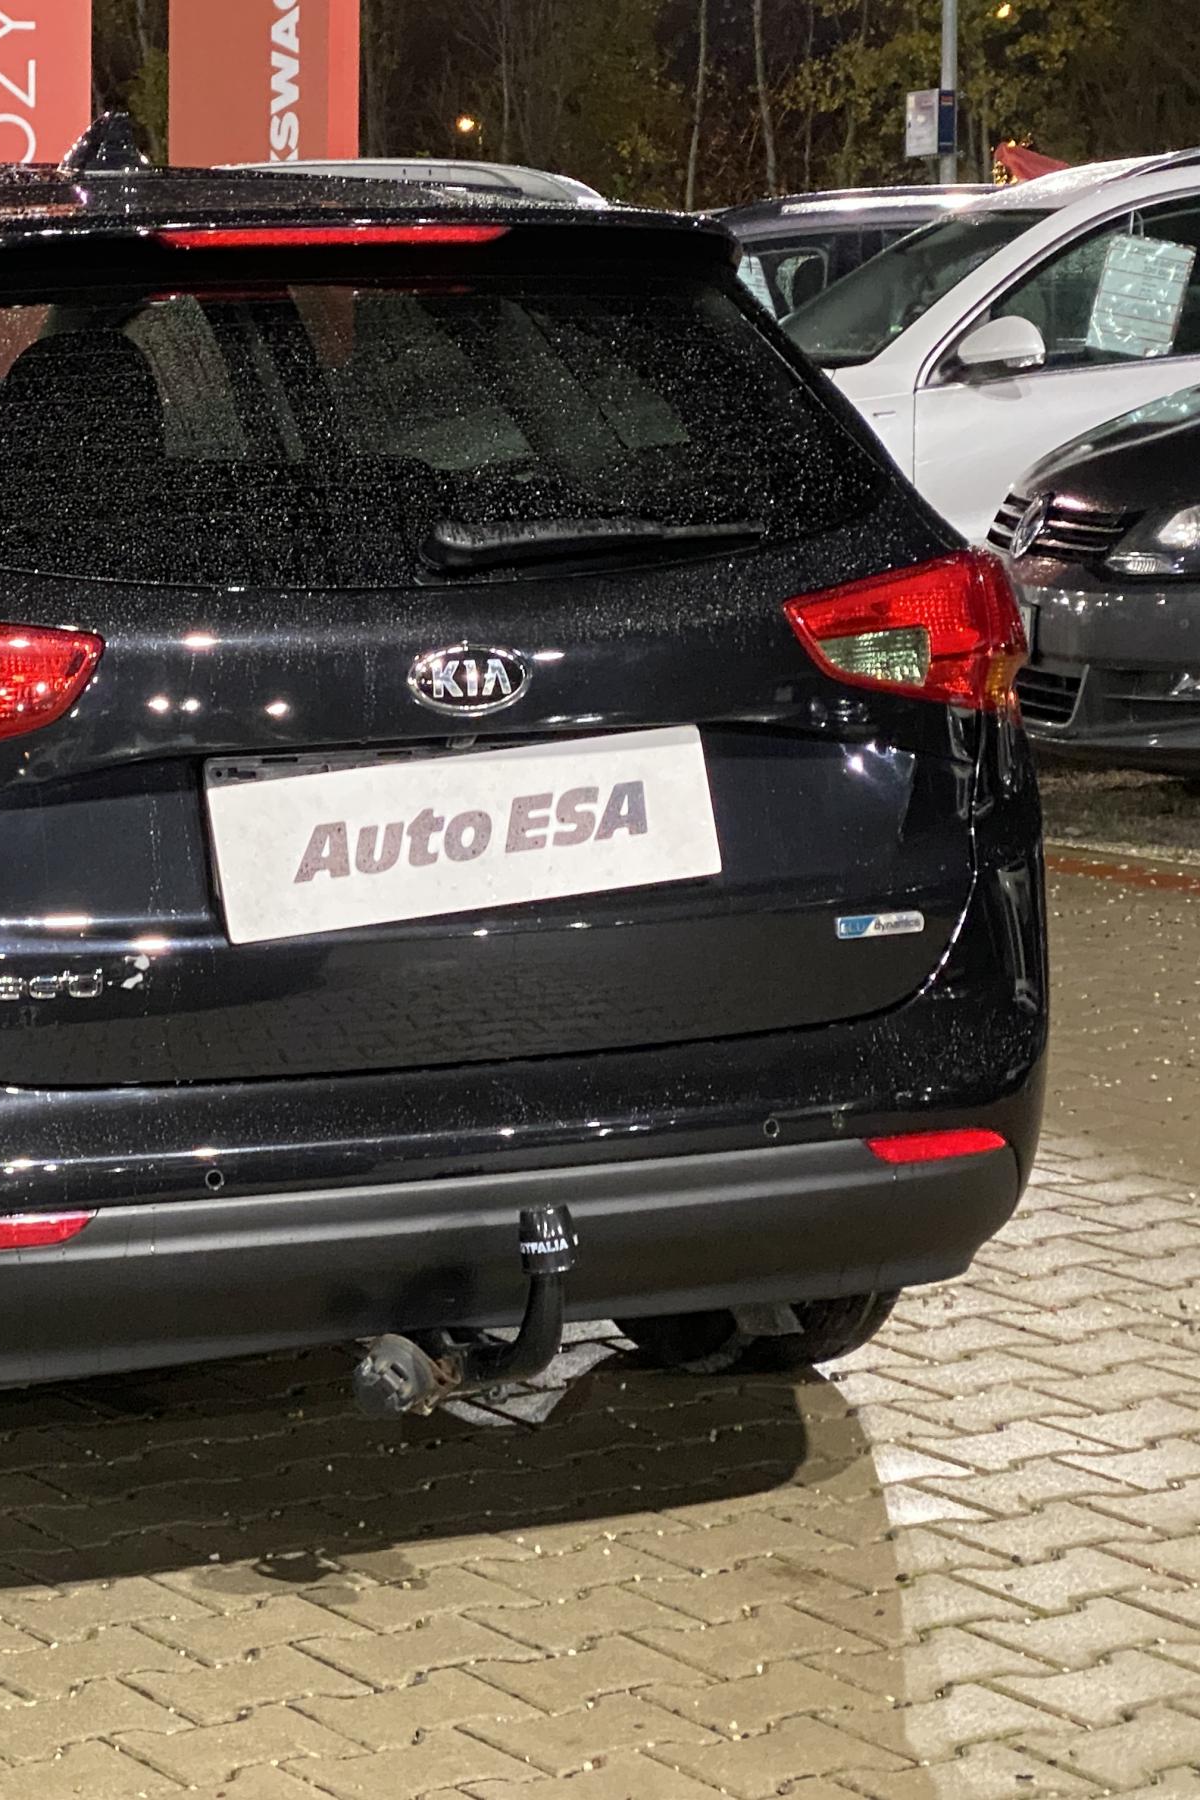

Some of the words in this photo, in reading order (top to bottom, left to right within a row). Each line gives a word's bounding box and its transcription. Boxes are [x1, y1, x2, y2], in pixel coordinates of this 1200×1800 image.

[269, 0, 300, 162] SWA
[430, 658, 513, 699] KIA
[293, 807, 493, 884] Auto
[504, 780, 648, 855] ESA
